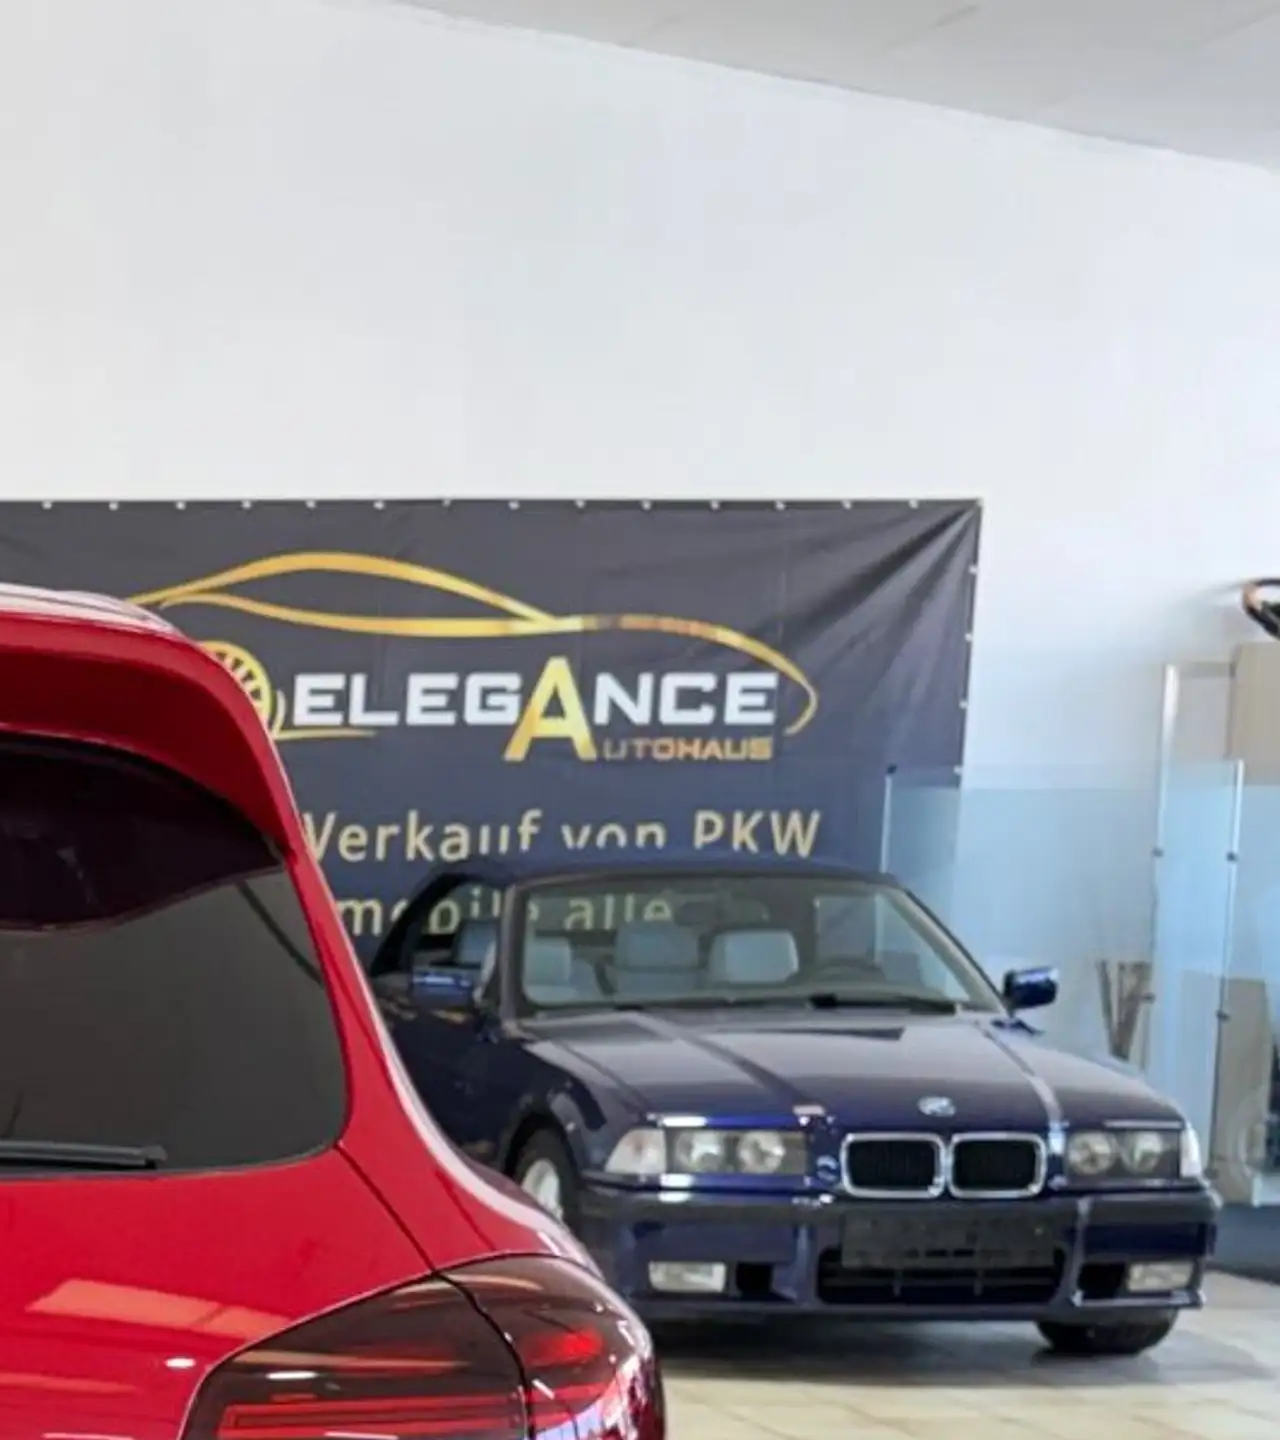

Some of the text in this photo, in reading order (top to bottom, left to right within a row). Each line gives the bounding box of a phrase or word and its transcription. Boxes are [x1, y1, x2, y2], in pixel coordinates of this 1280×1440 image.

[292, 656, 779, 761] ELEGANCE
[302, 808, 821, 863] Verkauf von PKW
